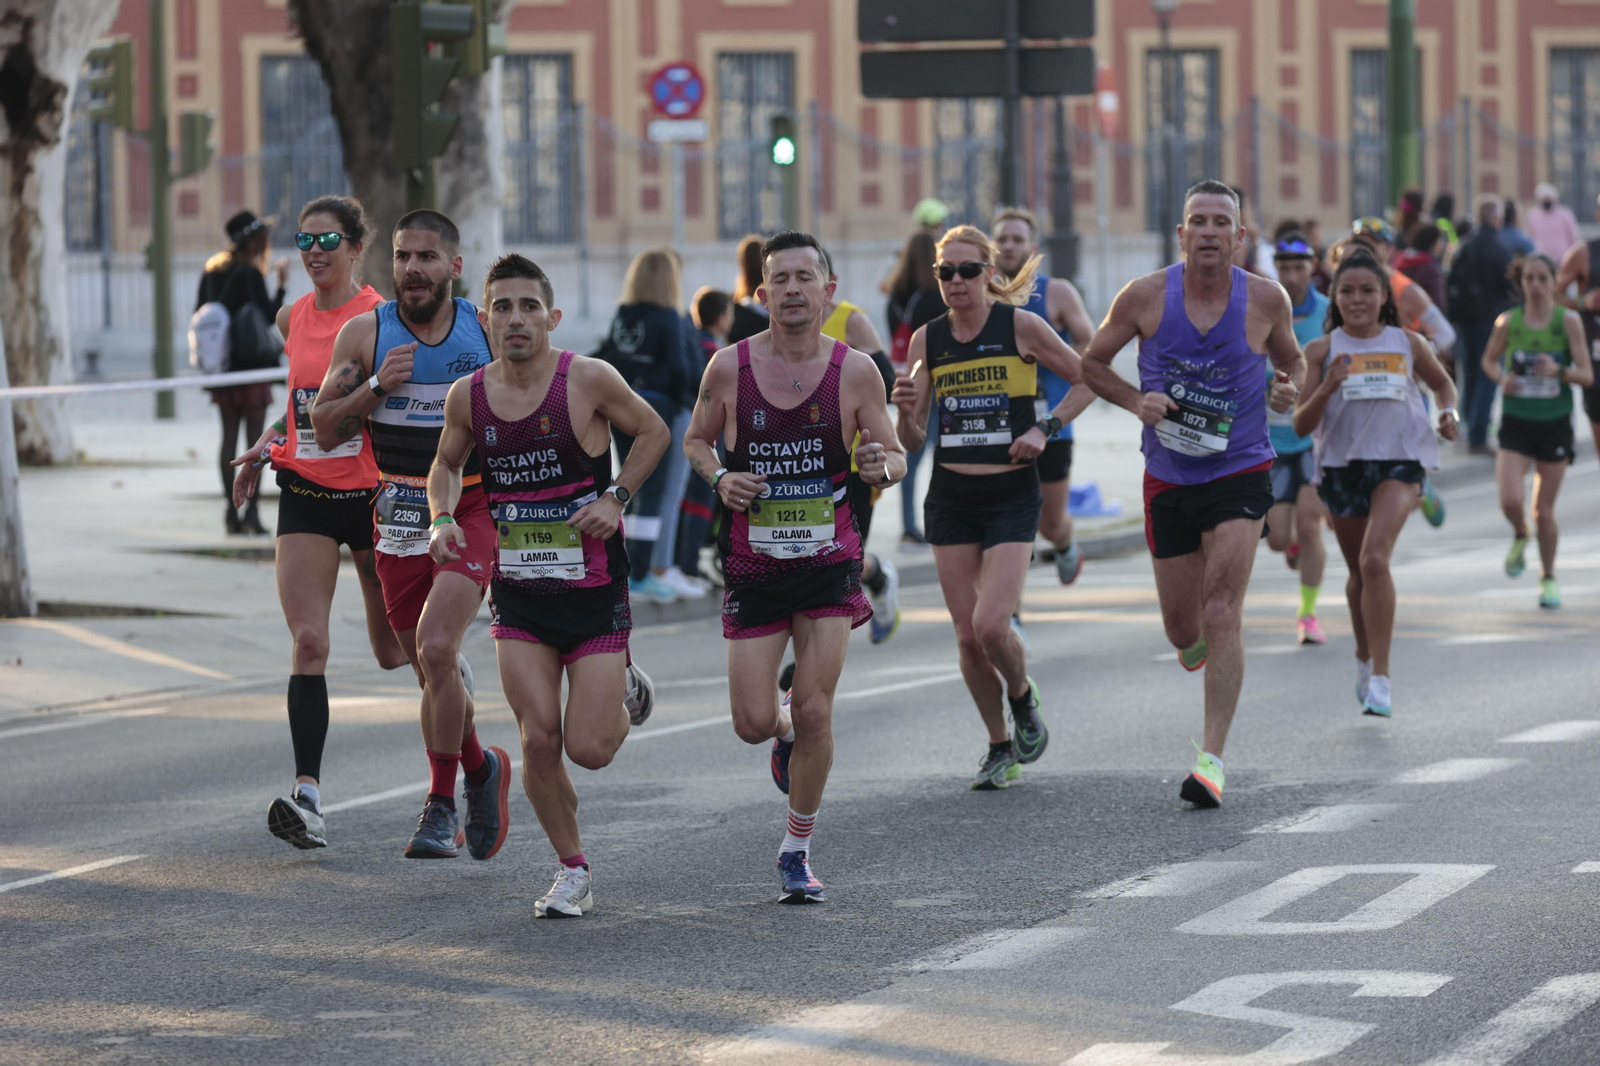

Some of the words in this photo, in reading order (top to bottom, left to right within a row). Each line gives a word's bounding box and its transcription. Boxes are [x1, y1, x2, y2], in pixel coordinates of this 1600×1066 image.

[935, 365, 1009, 389] WINCHESTER
[946, 384, 985, 396] DISTRICT
[959, 397, 1001, 409] ZURICH
[1186, 391, 1229, 411] ZURICH
[962, 418, 986, 431] 3158
[1183, 411, 1207, 428] 1873
[961, 436, 988, 445] SARAH
[1178, 428, 1202, 442] SAGIV
[748, 437, 823, 456] OCTAVUS
[486, 448, 558, 468] OCTAVUS
[749, 454, 825, 475] TRIATLÓN
[491, 463, 563, 485] TRIATLÓN
[332, 490, 367, 499] ULTRA
[398, 488, 428, 498] ZURI
[775, 483, 824, 496] ZURICH
[394, 509, 421, 523] 2350
[520, 507, 568, 519] ZURICH
[776, 509, 806, 522] 1212
[388, 528, 424, 539] PABLOTE
[523, 532, 552, 544] 1159
[772, 529, 813, 540] CALAVIA
[520, 552, 559, 562] LAMATA
